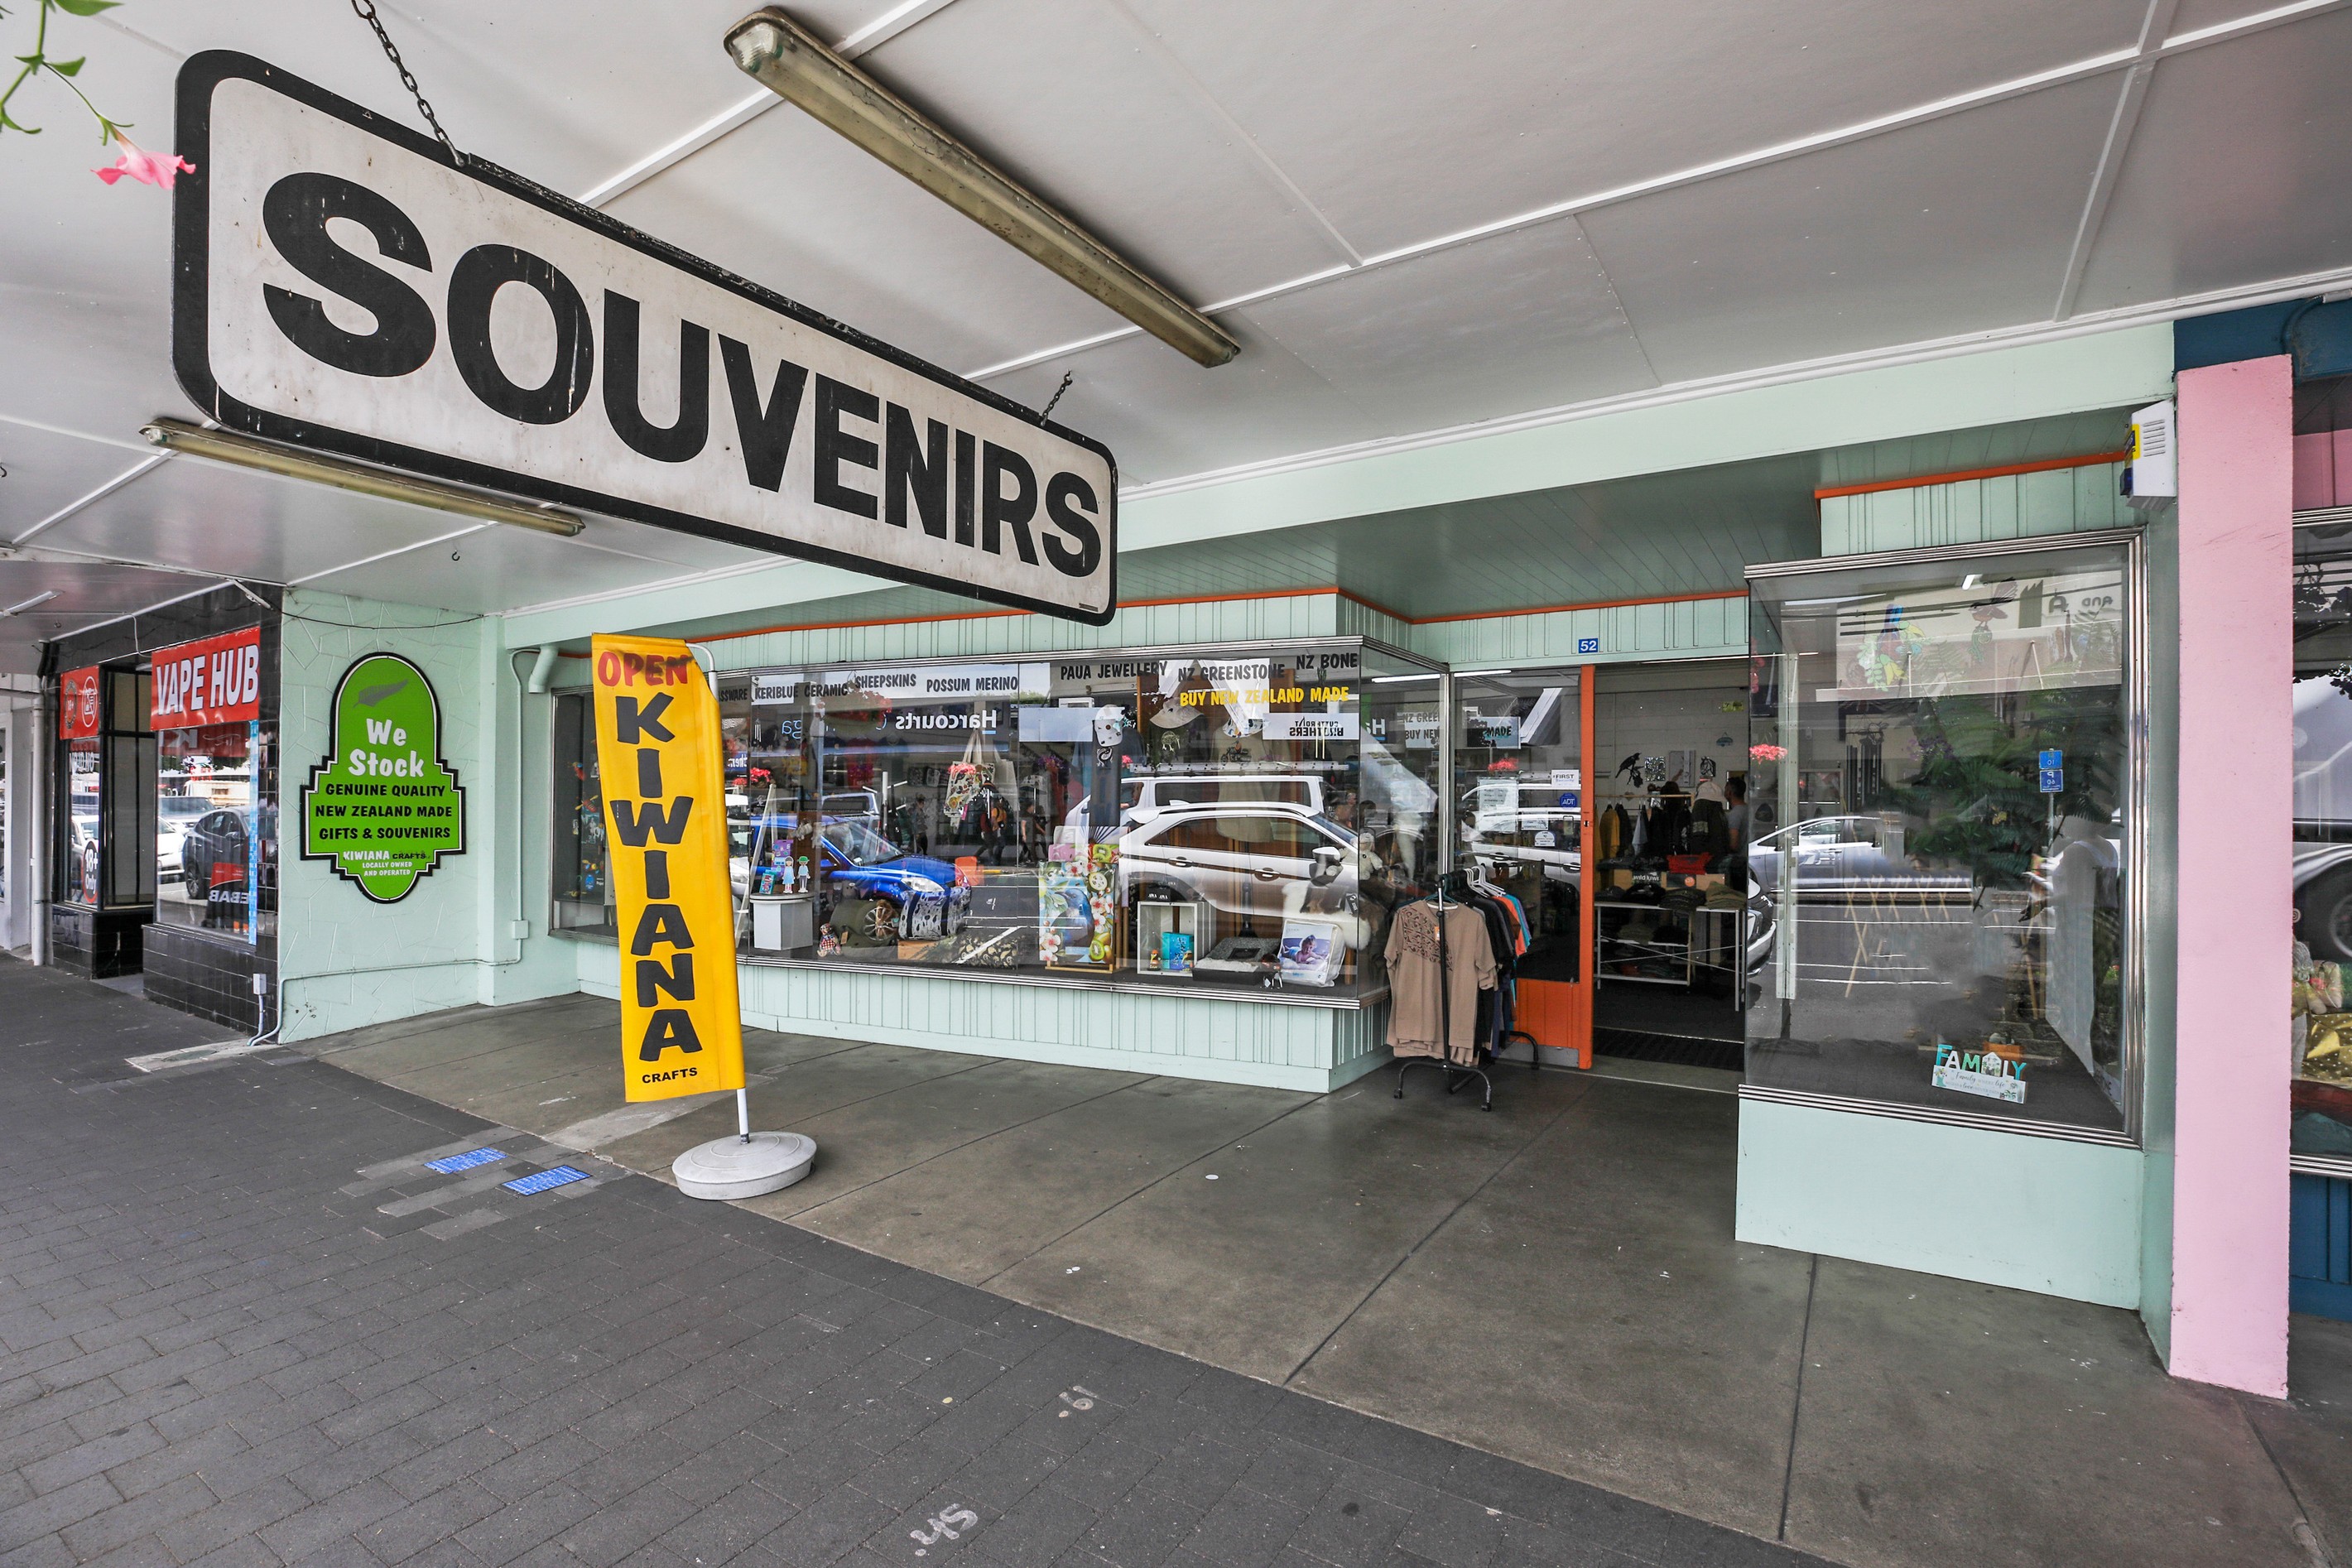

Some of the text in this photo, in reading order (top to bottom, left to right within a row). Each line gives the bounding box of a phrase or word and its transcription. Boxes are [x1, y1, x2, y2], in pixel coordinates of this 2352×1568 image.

[263, 172, 1101, 577] SOUVENIRS
[1580, 640, 1597, 652] 52
[598, 652, 689, 686] OPEN
[1296, 653, 1358, 670] NZ BONE
[1061, 661, 1167, 680] PAUA JEWELLERY
[1178, 664, 1285, 681] NZ GREENSTONE
[156, 644, 259, 715] VAPE HUB
[855, 674, 916, 689] SHEEPSKINS
[926, 676, 1018, 692] POSSUM MERINO
[1180, 687, 1349, 706] BUY NEW ZEALAND MADE
[366, 718, 406, 746] We
[1405, 729, 1420, 739] BUY
[1487, 726, 1512, 737] MADE
[349, 748, 424, 777] Stock
[326, 783, 445, 796] GENUINE QUALITY
[315, 806, 452, 817] NEW ZEALAND MADE
[320, 827, 450, 839] GIFTS & SOUVENIRS
[85, 849, 99, 872] 18+
[343, 851, 390, 860] KIWIANA
[610, 692, 703, 1062] KIWIANA
[642, 1067, 698, 1084] CRAFTS
